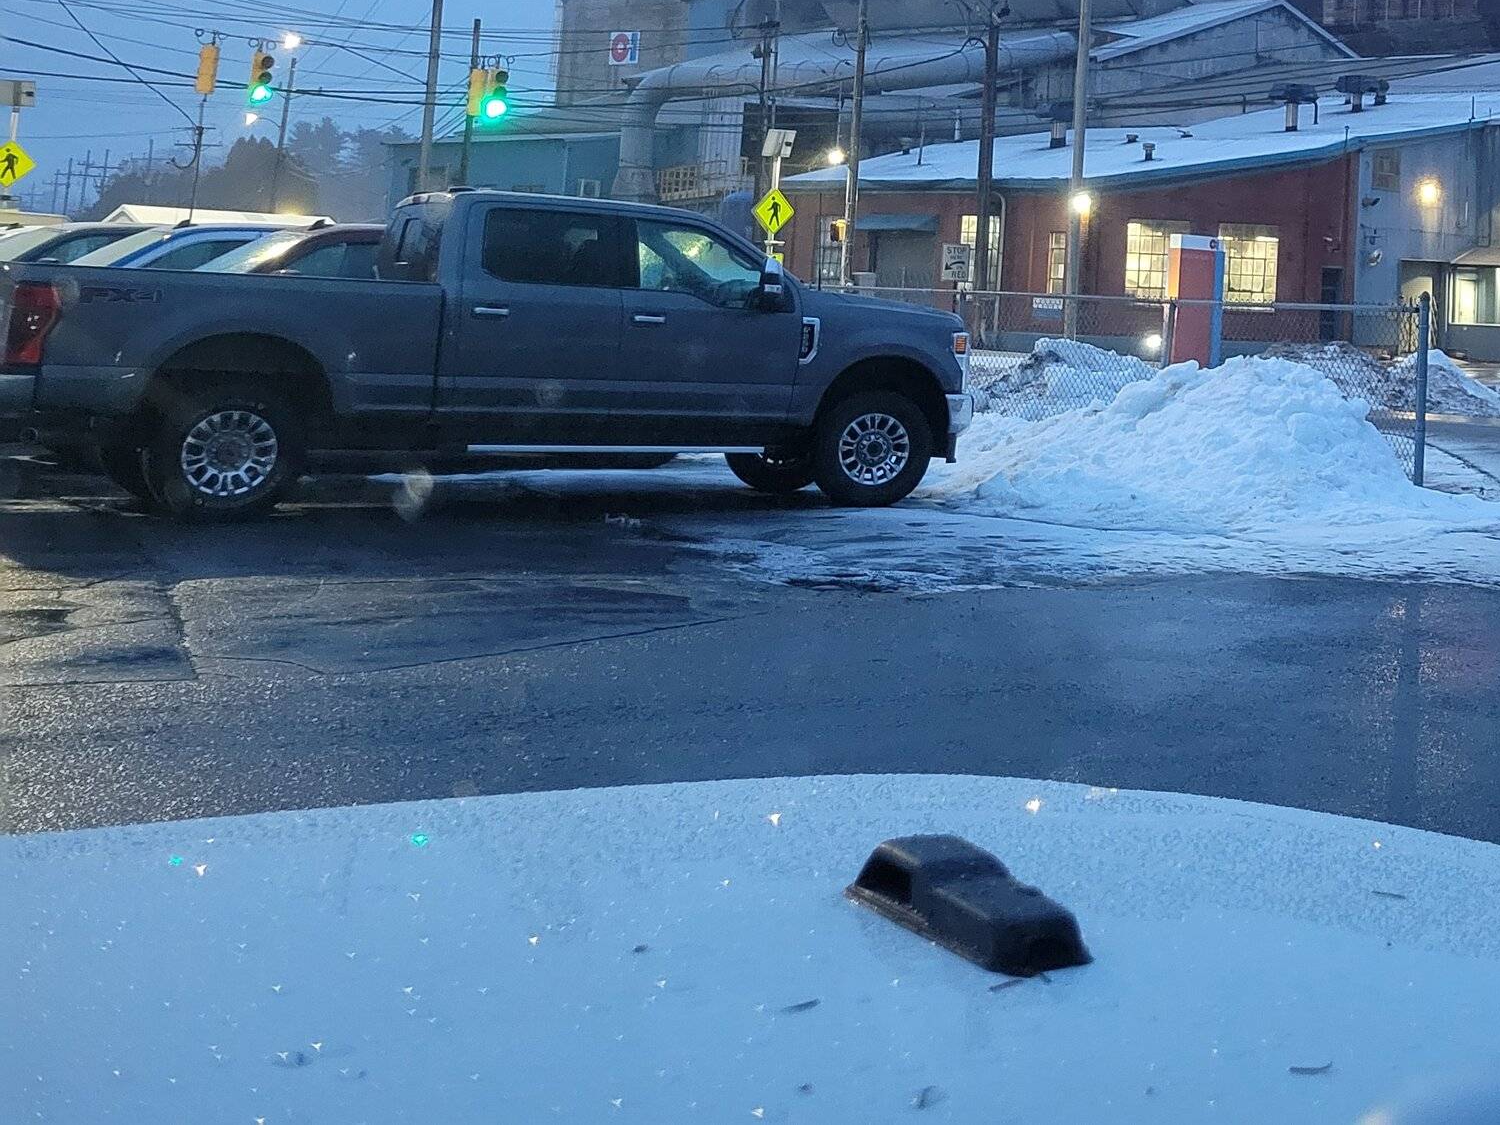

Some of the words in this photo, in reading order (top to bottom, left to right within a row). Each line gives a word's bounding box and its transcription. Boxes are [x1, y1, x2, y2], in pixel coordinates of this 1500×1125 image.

[947, 246, 967, 255] STOP
[951, 271, 967, 279] RED
[80, 286, 161, 304] FX4
